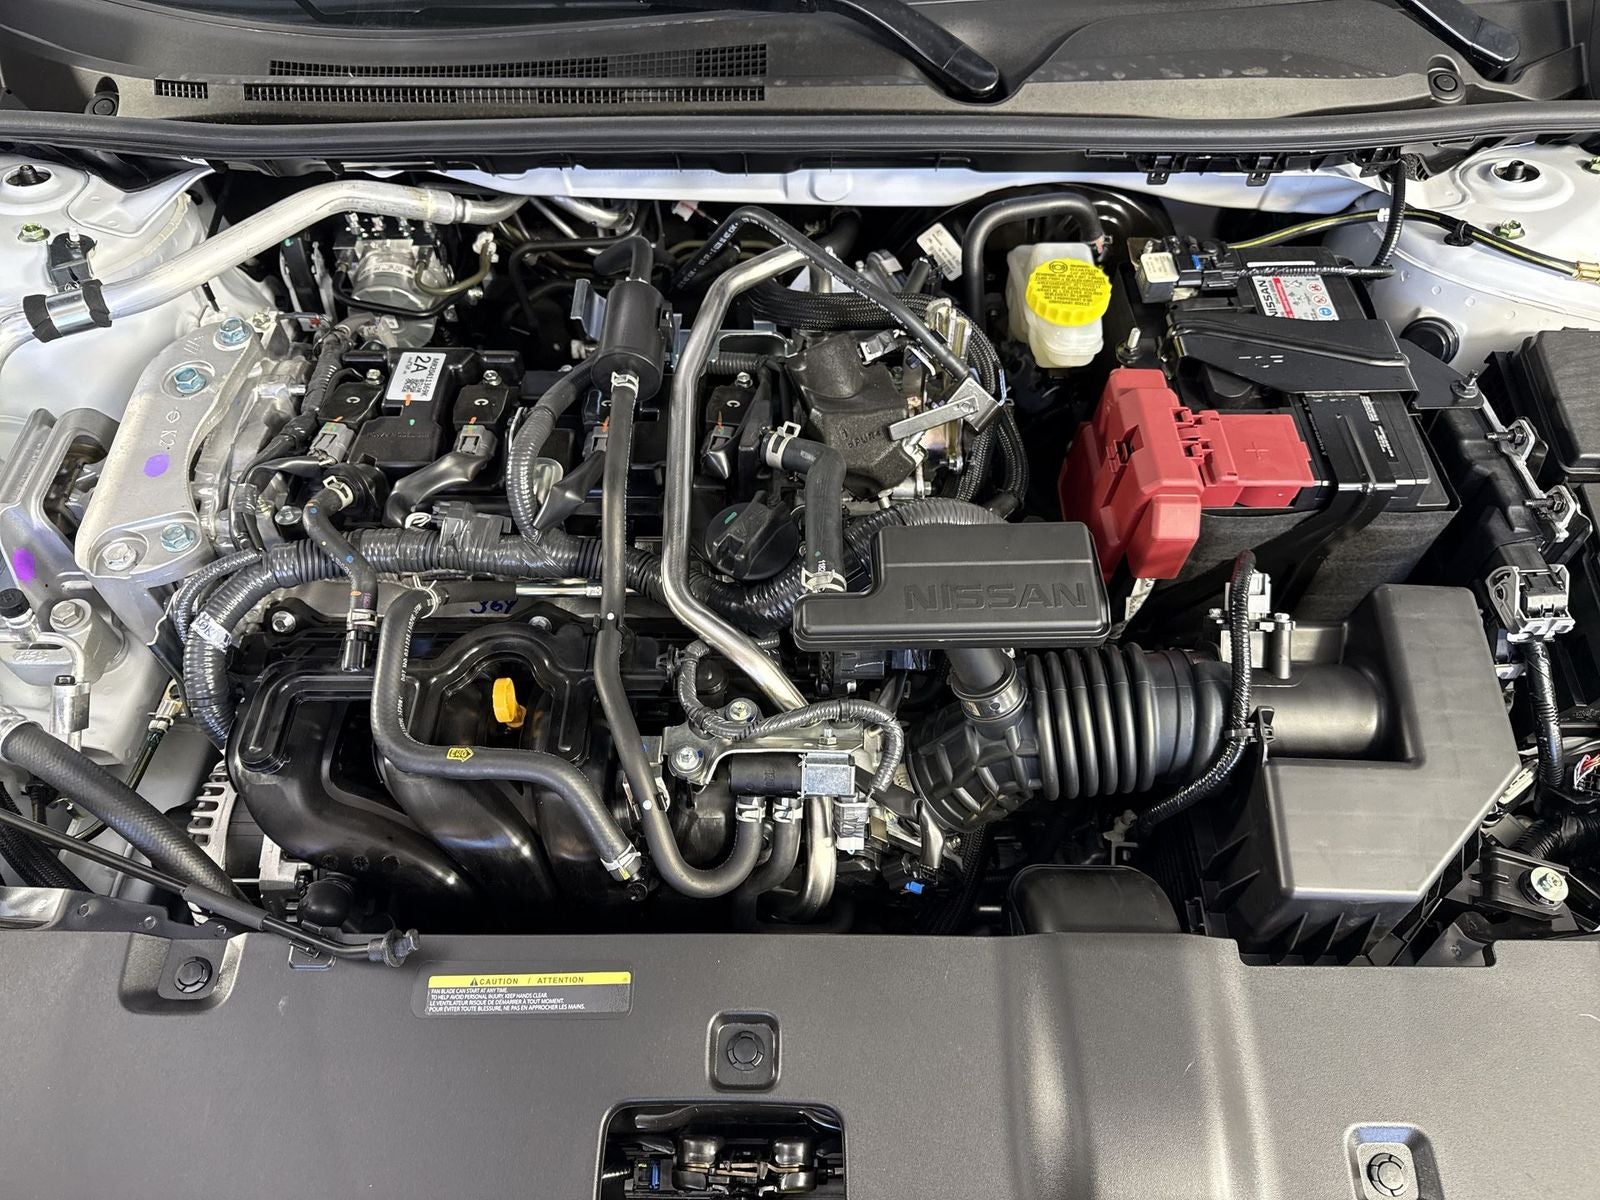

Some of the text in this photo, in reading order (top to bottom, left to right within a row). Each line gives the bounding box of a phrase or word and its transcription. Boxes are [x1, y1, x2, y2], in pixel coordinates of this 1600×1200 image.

[410, 354, 432, 374] 2A
[903, 581, 1088, 612] NISSAN
[479, 977, 519, 987] CAUTION
[536, 975, 585, 985] ATTENTION
[464, 993, 488, 1001] PERSONAL
[515, 992, 533, 1000] HANDS
[428, 1005, 444, 1013] POUR
[527, 1003, 558, 1011] APPROCHER
[435, 999, 468, 1007] VENTILATEUR
[467, 999, 487, 1007] RISQUE
